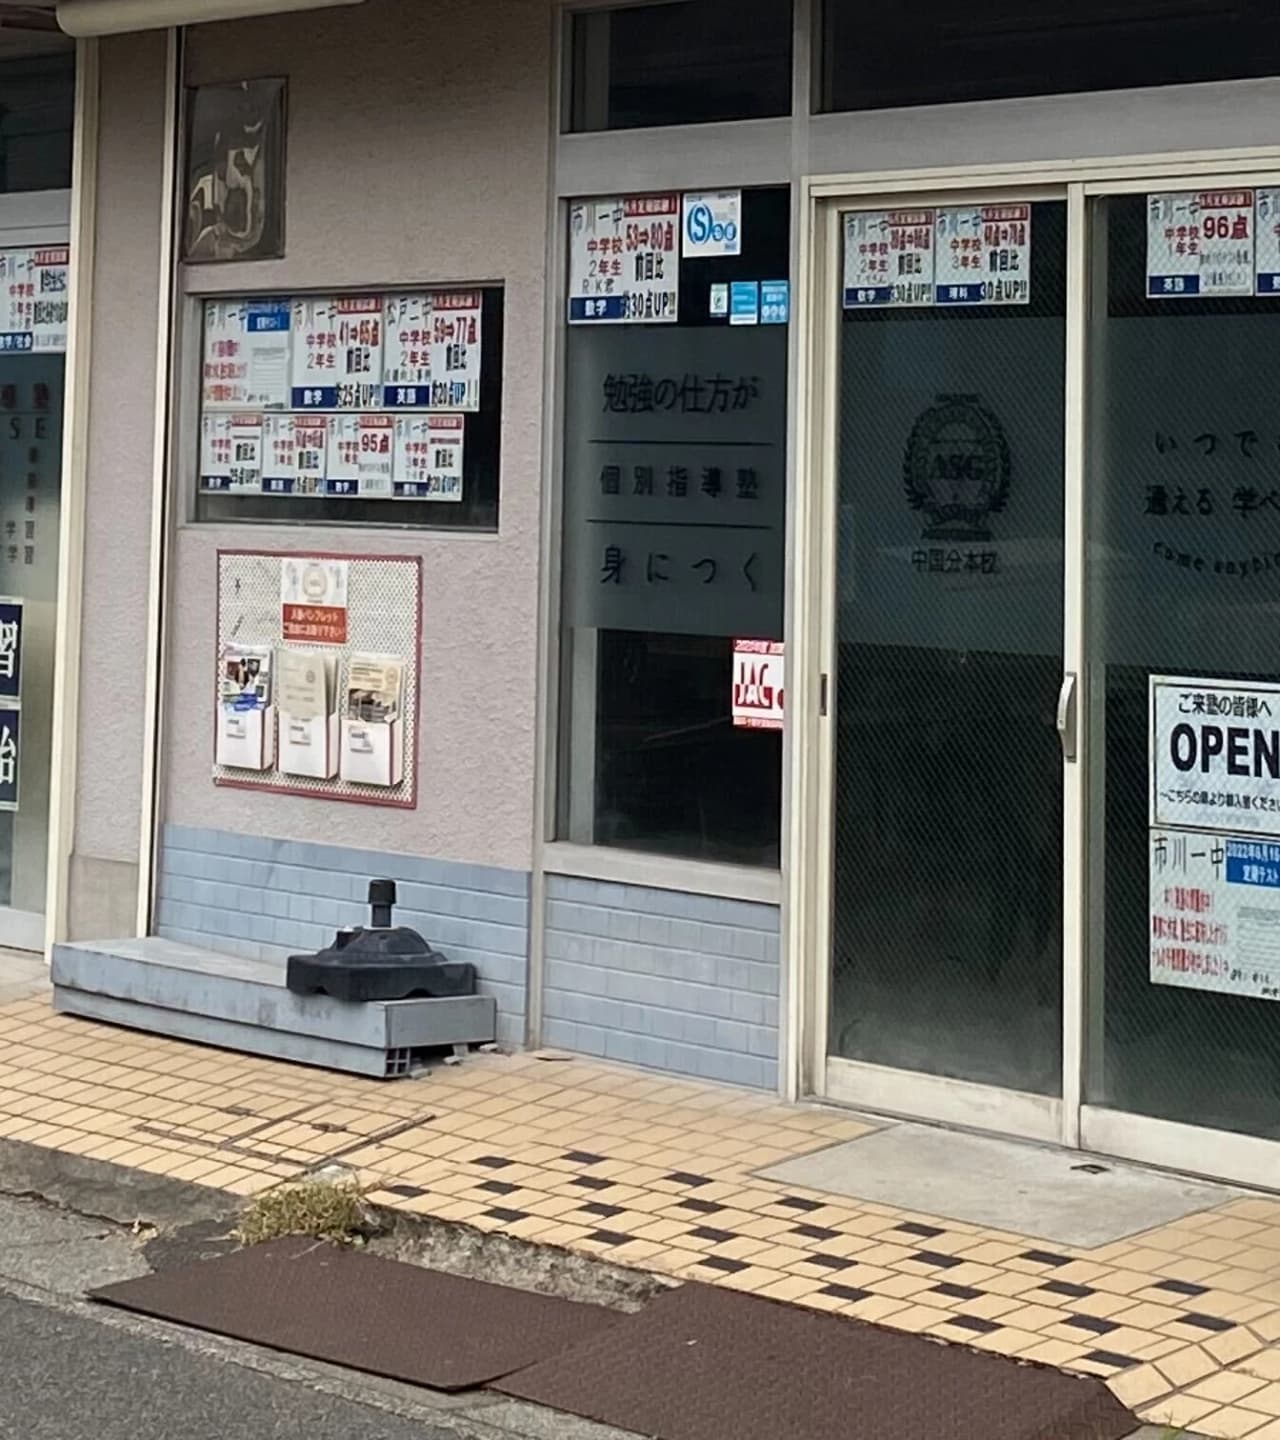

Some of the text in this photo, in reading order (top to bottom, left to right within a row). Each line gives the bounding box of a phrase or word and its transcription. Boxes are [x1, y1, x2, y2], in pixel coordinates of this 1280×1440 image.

[1203, 215, 1249, 240] 96点
[602, 372, 759, 413] 勉強の仕方が
[361, 432, 390, 454] 95点
[600, 464, 759, 500] 個別指導塾
[600, 545, 758, 593] 身につく
[1170, 722, 1280, 779] OPEN
[1153, 833, 1224, 881] 市川一中
